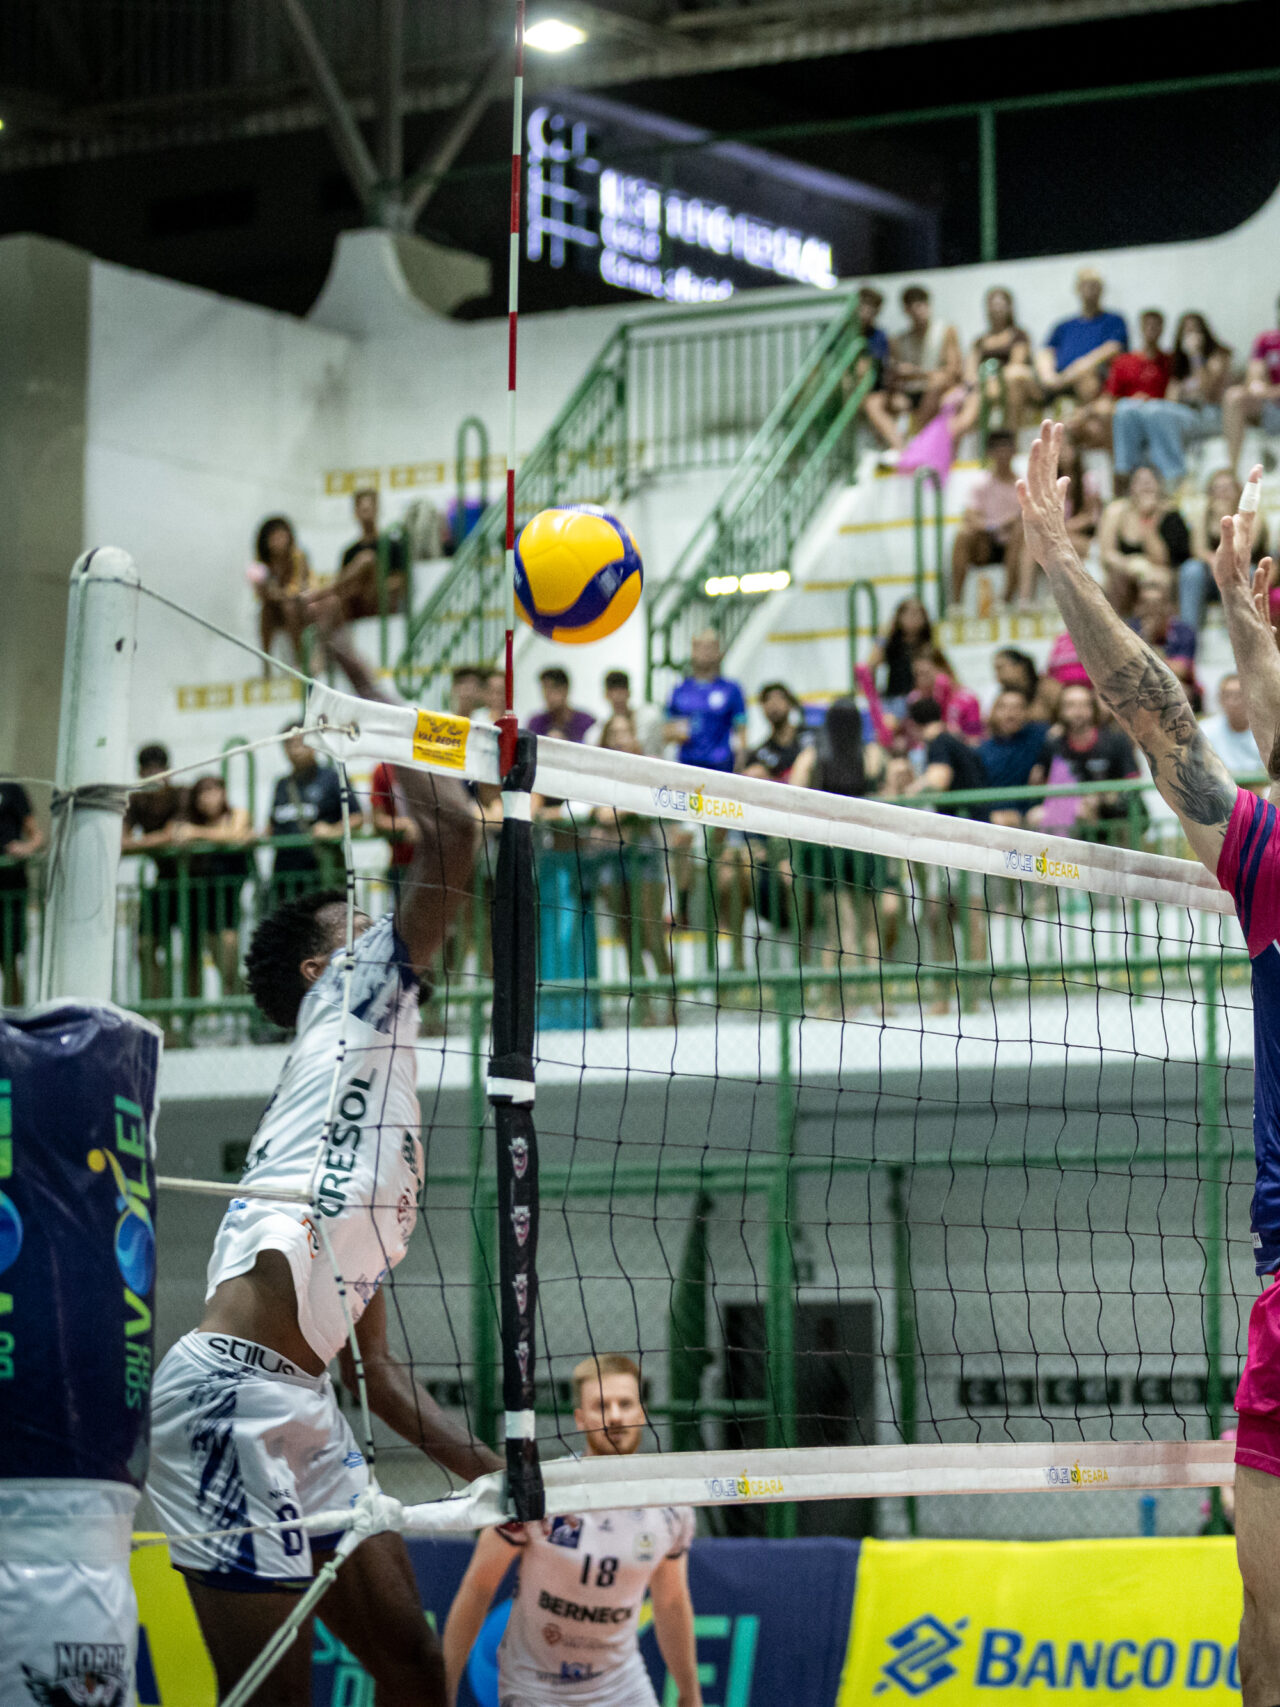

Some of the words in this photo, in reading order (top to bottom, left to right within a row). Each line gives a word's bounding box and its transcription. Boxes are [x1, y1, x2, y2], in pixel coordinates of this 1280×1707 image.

[318, 1067, 378, 1218] CRESOL
[581, 1554, 618, 1587] 18
[975, 1628, 1177, 1689] BANCO
